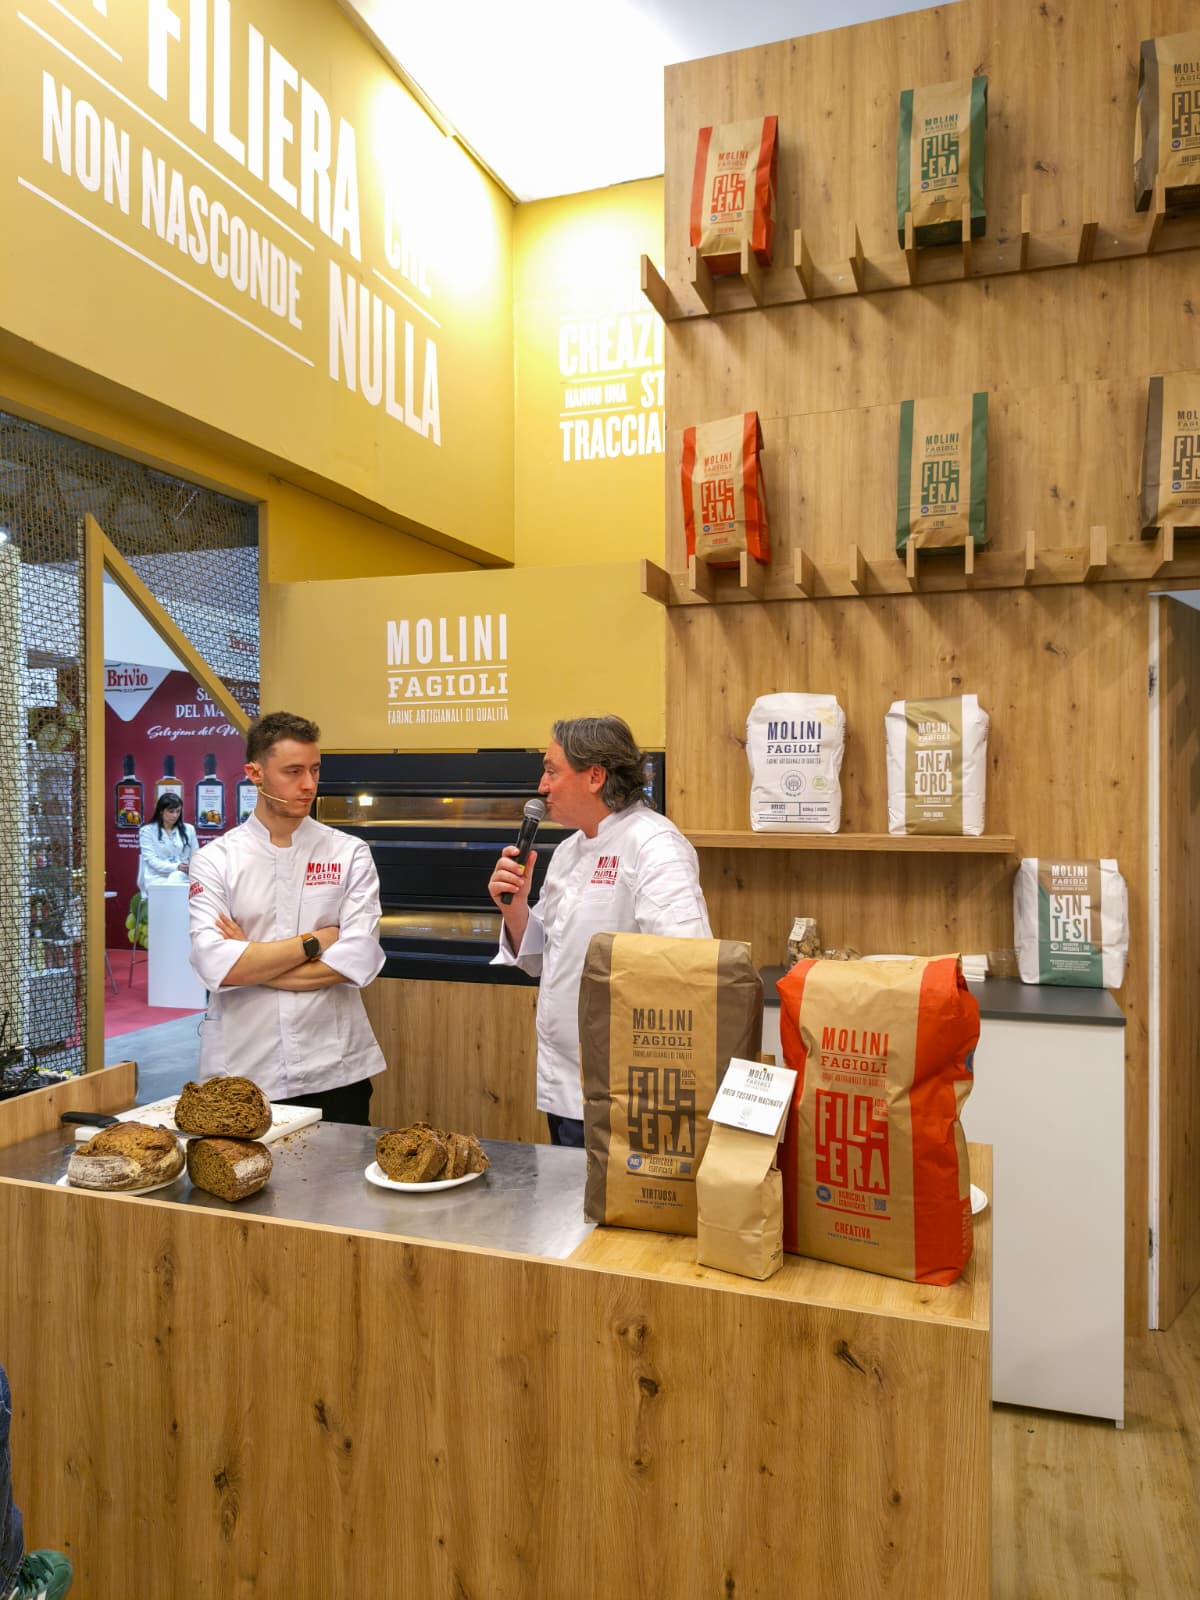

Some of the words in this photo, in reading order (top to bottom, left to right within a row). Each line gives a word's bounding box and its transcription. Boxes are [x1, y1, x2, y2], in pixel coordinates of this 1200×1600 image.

[924, 114, 959, 126] MOLINI
[148, 0, 361, 263] FILIERA
[718, 151, 749, 161] MOLINI
[42, 69, 130, 216] NON
[142, 145, 303, 331] NASCONDE
[329, 258, 441, 448] NULLA
[560, 410, 665, 463] TRACCIA
[926, 432, 959, 446] MOLINI
[704, 451, 732, 465] MOLINI
[387, 613, 507, 666] MOLINI
[107, 668, 148, 687] Brivio
[387, 672, 508, 699] FAGIOLI
[175, 704, 200, 718] DEL
[388, 710, 414, 726] FARINE
[416, 707, 463, 724] ARTIGIANALI
[465, 708, 474, 722] DI
[476, 704, 508, 722] QUALITÀ
[198, 727, 214, 737] del
[767, 721, 822, 740] MOLINI
[918, 721, 951, 734] MOLINI
[767, 744, 821, 754] FAGIOLI
[307, 862, 341, 874] MOLINI
[1052, 865, 1088, 877] MOLINI
[306, 873, 341, 881] FAGIOLI
[632, 1007, 693, 1032] MOLINI
[632, 1034, 693, 1048] FAGIOLI
[821, 1026, 889, 1057] MOLINI
[820, 1055, 887, 1074] FAGIOLI
[748, 1068, 774, 1082] MOLINI
[736, 1090, 758, 1103] TOSTATO
[758, 1096, 784, 1109] MACINATO
[641, 1187, 678, 1202] VIRTUOSA
[834, 1221, 872, 1241] CREATIVA
